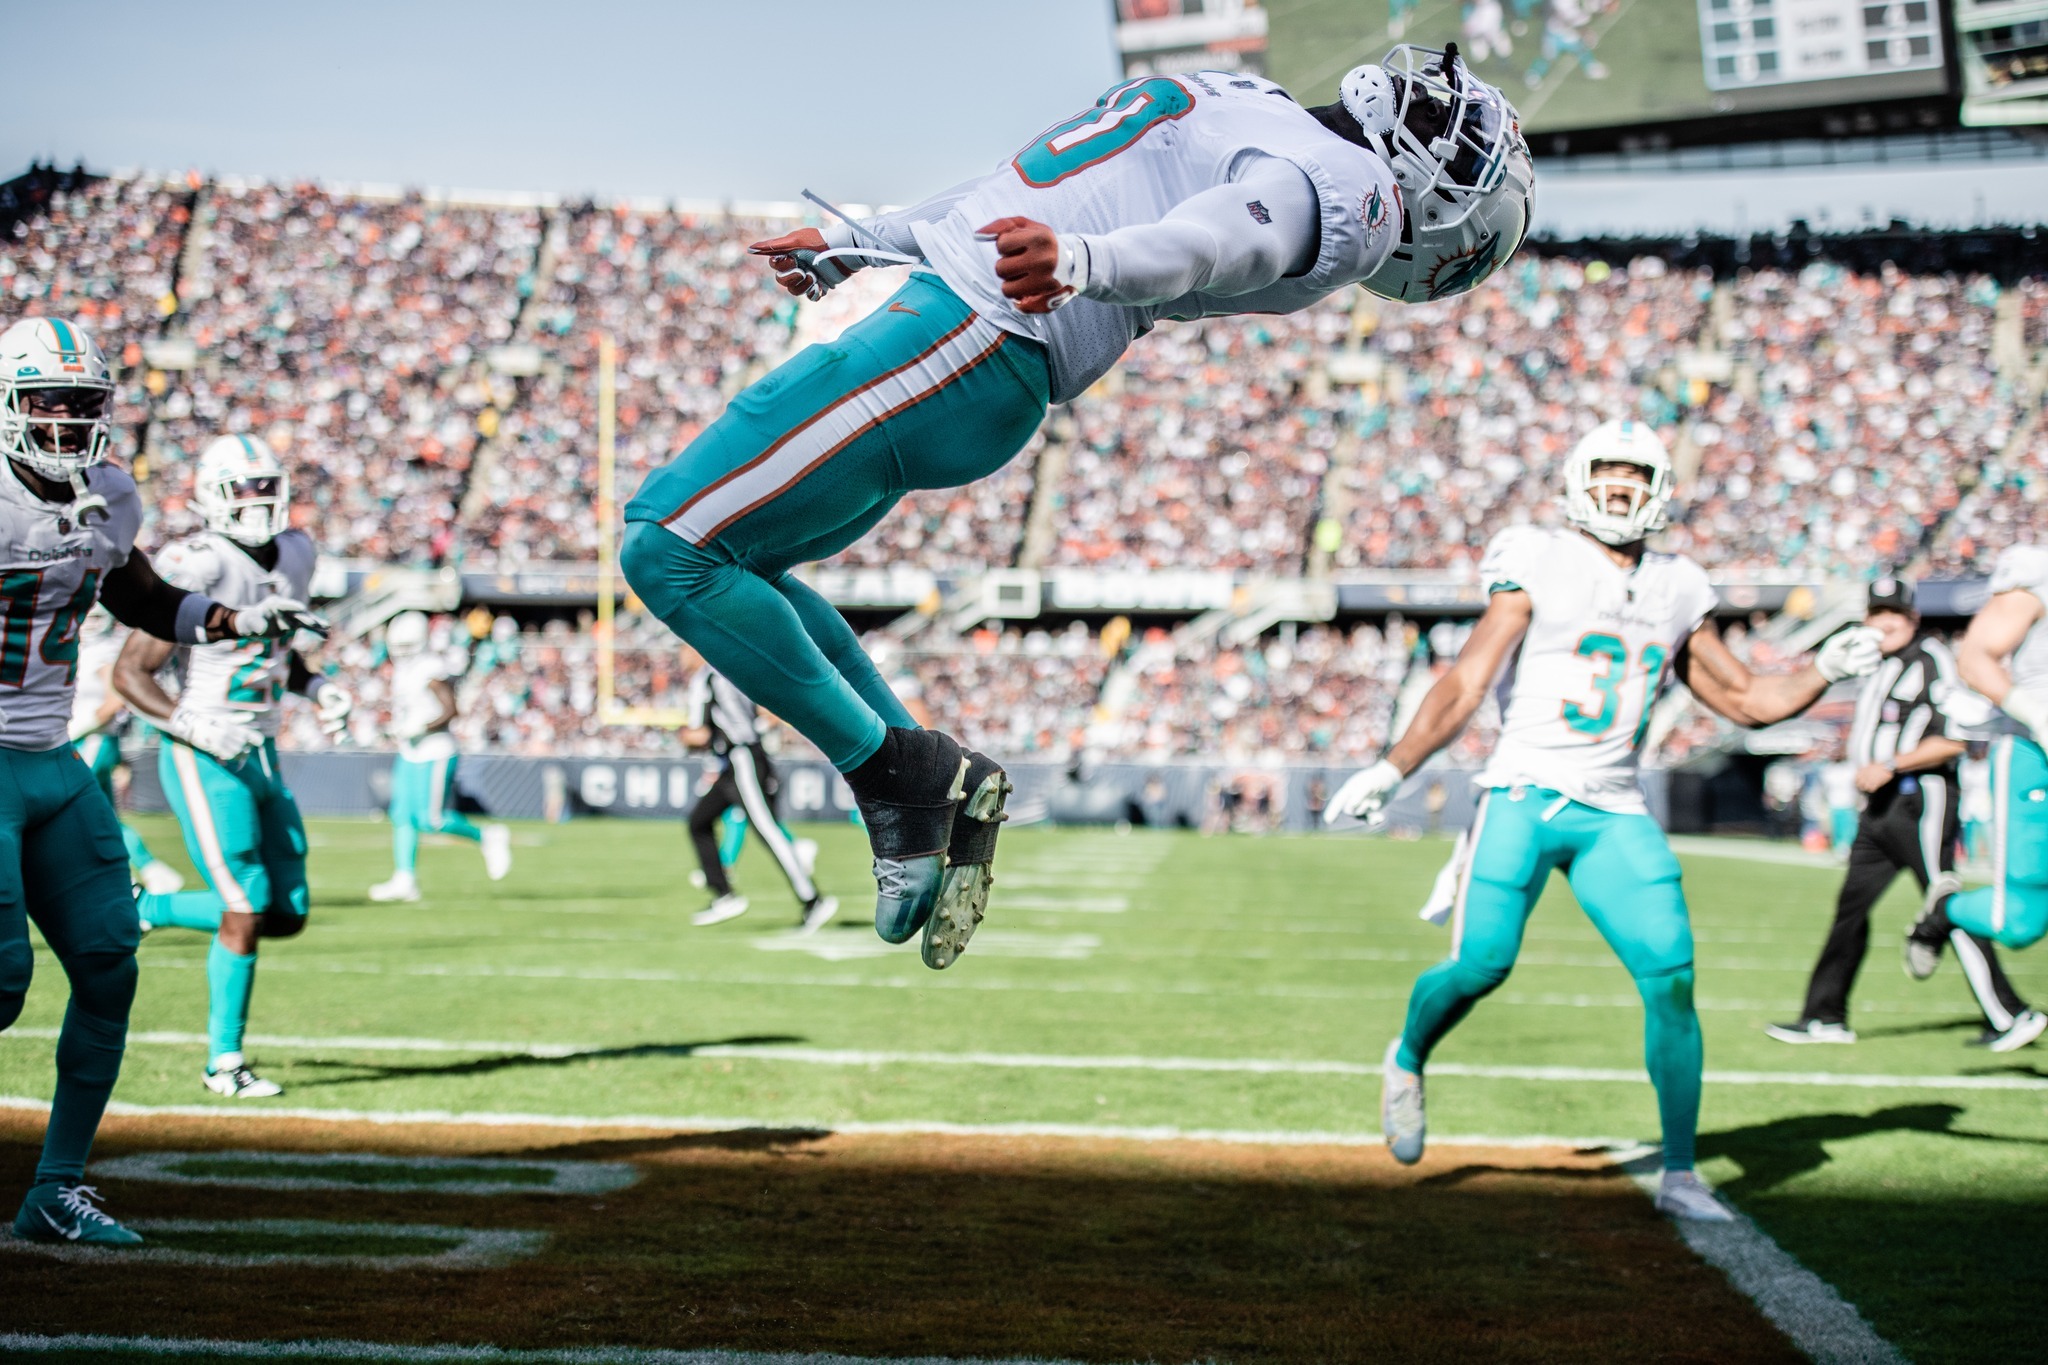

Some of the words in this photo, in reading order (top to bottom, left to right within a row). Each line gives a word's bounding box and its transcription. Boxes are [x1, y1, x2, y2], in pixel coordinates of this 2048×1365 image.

[1247, 203, 1267, 223] NFL
[28, 546, 94, 562] Dolphins
[0, 568, 102, 688] 14
[1561, 630, 1671, 750] 31
